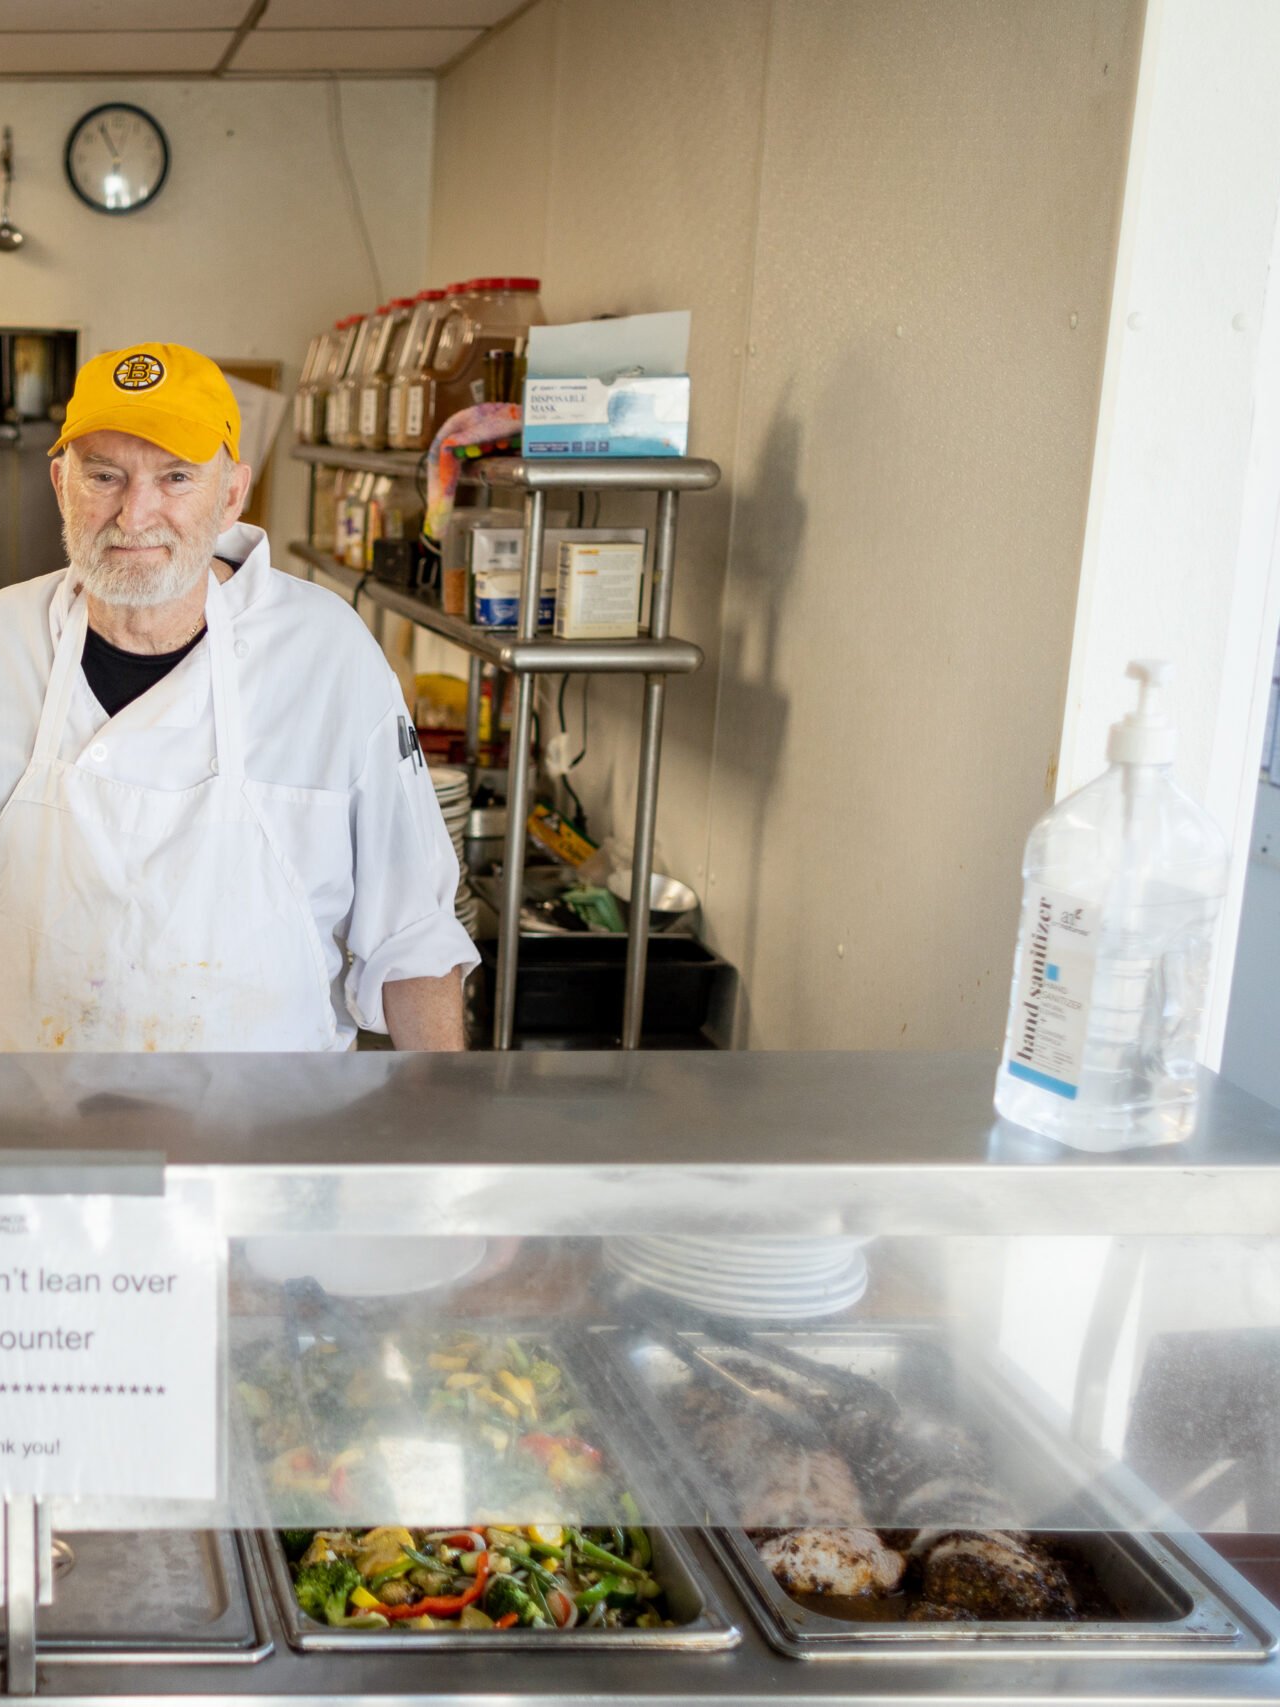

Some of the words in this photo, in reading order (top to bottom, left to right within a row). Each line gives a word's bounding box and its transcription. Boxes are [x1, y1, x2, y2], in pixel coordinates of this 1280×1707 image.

[125, 361, 152, 382] B
[530, 404, 557, 413] MASK
[1016, 1000, 1040, 1061] hand
[1028, 896, 1053, 999] sanitizer
[39, 1267, 102, 1294] lean
[111, 1272, 178, 1294] over
[22, 1437, 61, 1460] you!
